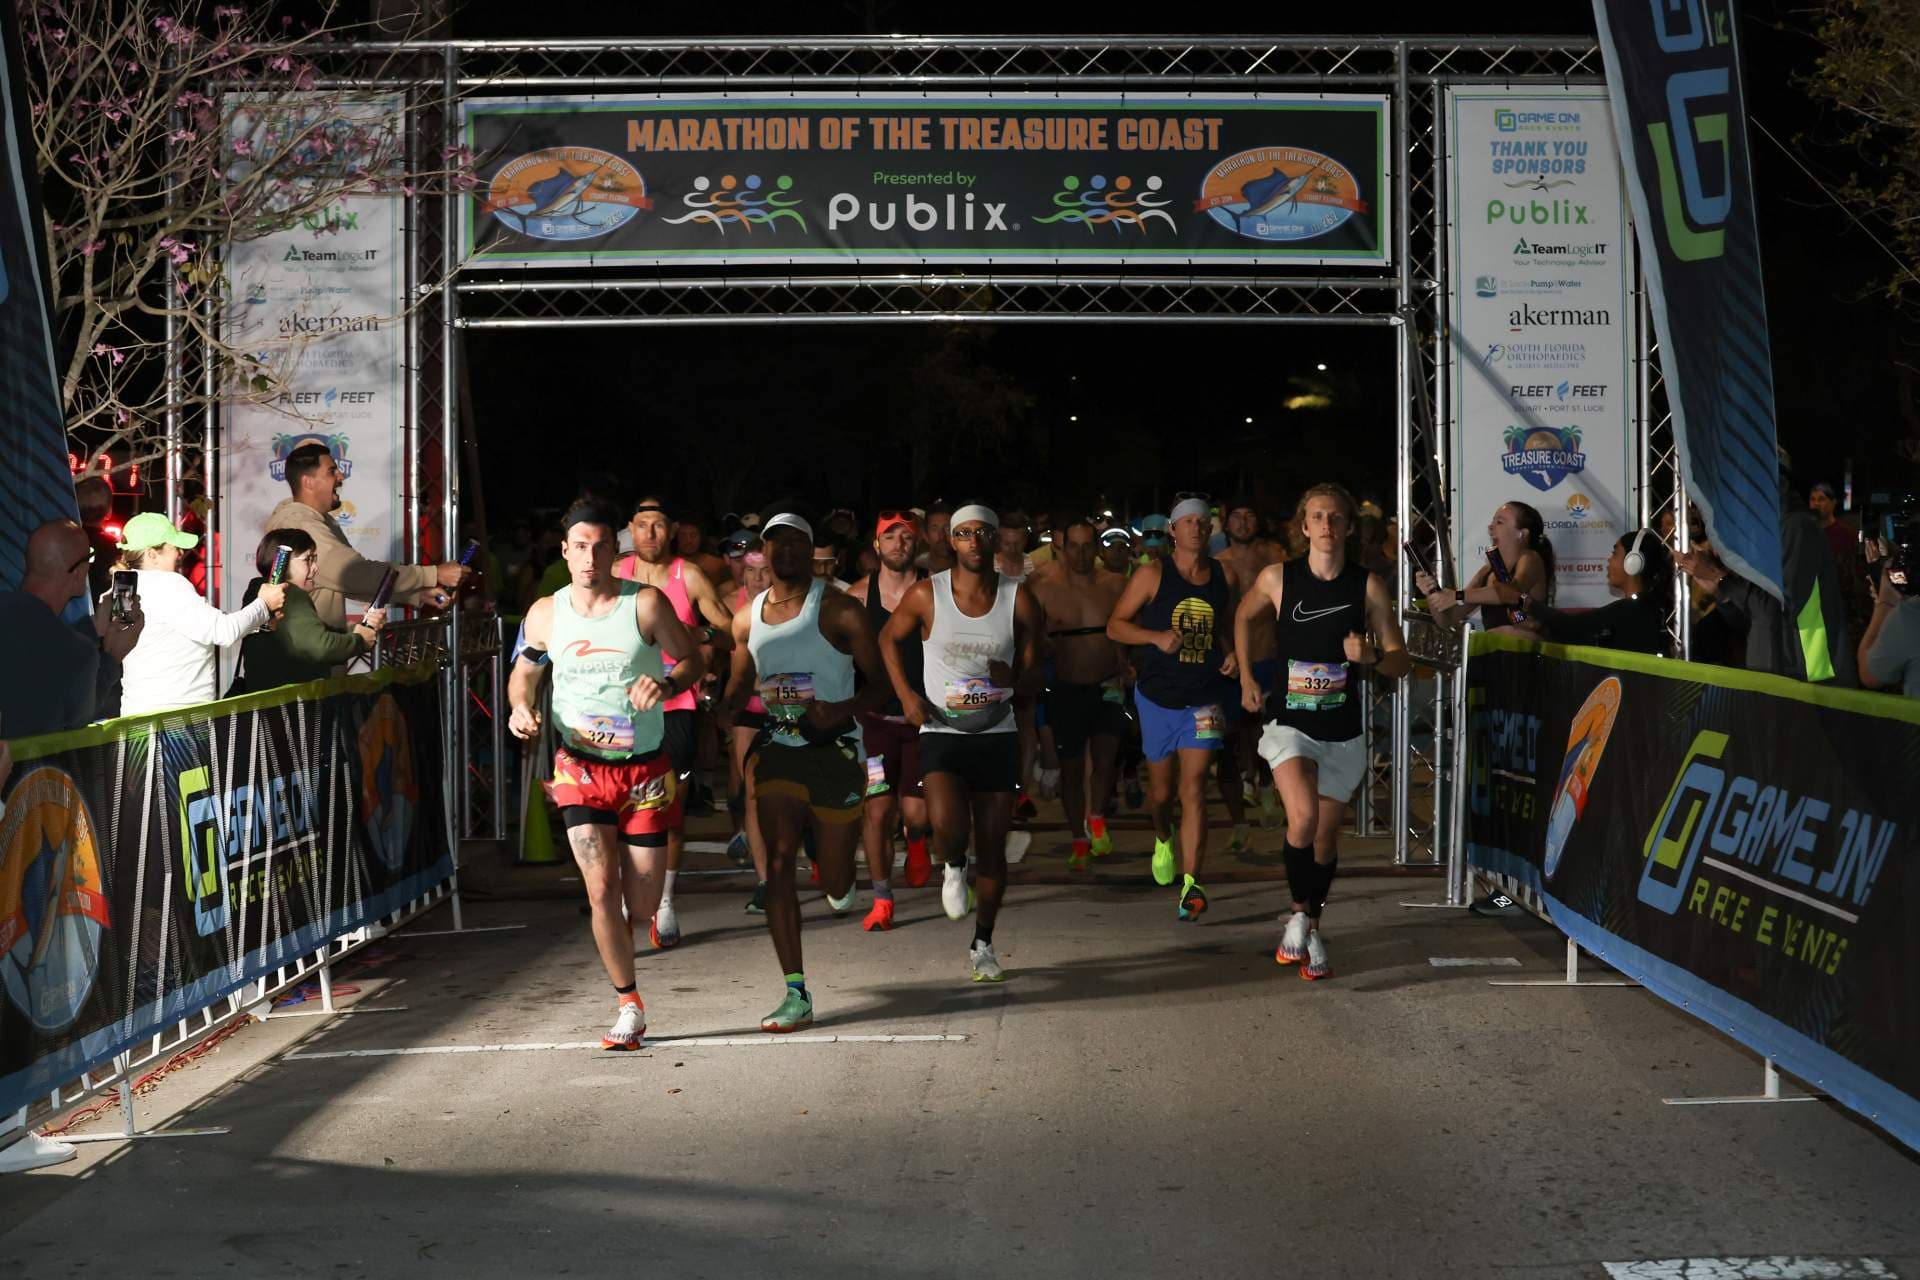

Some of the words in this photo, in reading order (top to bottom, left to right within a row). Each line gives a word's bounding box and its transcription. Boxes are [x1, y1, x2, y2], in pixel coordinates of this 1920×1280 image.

[1518, 113, 1554, 123] GAME
[626, 117, 809, 152] MARATHON
[819, 117, 860, 150] OF
[869, 117, 931, 150] THE
[939, 117, 1107, 151] TREASURE
[1117, 117, 1223, 151] COAST
[1490, 141, 1548, 157] THANK
[1553, 141, 1588, 157] YOU
[1269, 151, 1281, 161] THE
[1492, 159, 1586, 174] SPONSORS
[873, 171, 953, 185] Presented
[957, 171, 977, 188] by
[828, 192, 1008, 231] Publix
[1487, 200, 1588, 224] Publix
[1531, 244, 1607, 257] TeamLogicIT
[1531, 280, 1554, 289] Pump
[1509, 303, 1611, 326] akerman
[1507, 344, 1541, 352] SOUTH
[1544, 344, 1586, 352] FLORIDA
[1507, 352, 1586, 361] ORTHOPAEDICS
[340, 392, 375, 403] FEET
[1511, 385, 1554, 397] FLEET
[1572, 385, 1607, 397] FEET
[1503, 450, 1551, 468] TREASURE
[1553, 450, 1585, 468] COAST
[1577, 564, 1604, 572] GUYS
[1304, 678, 1331, 690] 332
[775, 686, 798, 700] 155
[963, 692, 988, 705] 265
[588, 730, 615, 744] 327
[1710, 776, 1831, 886] GAME
